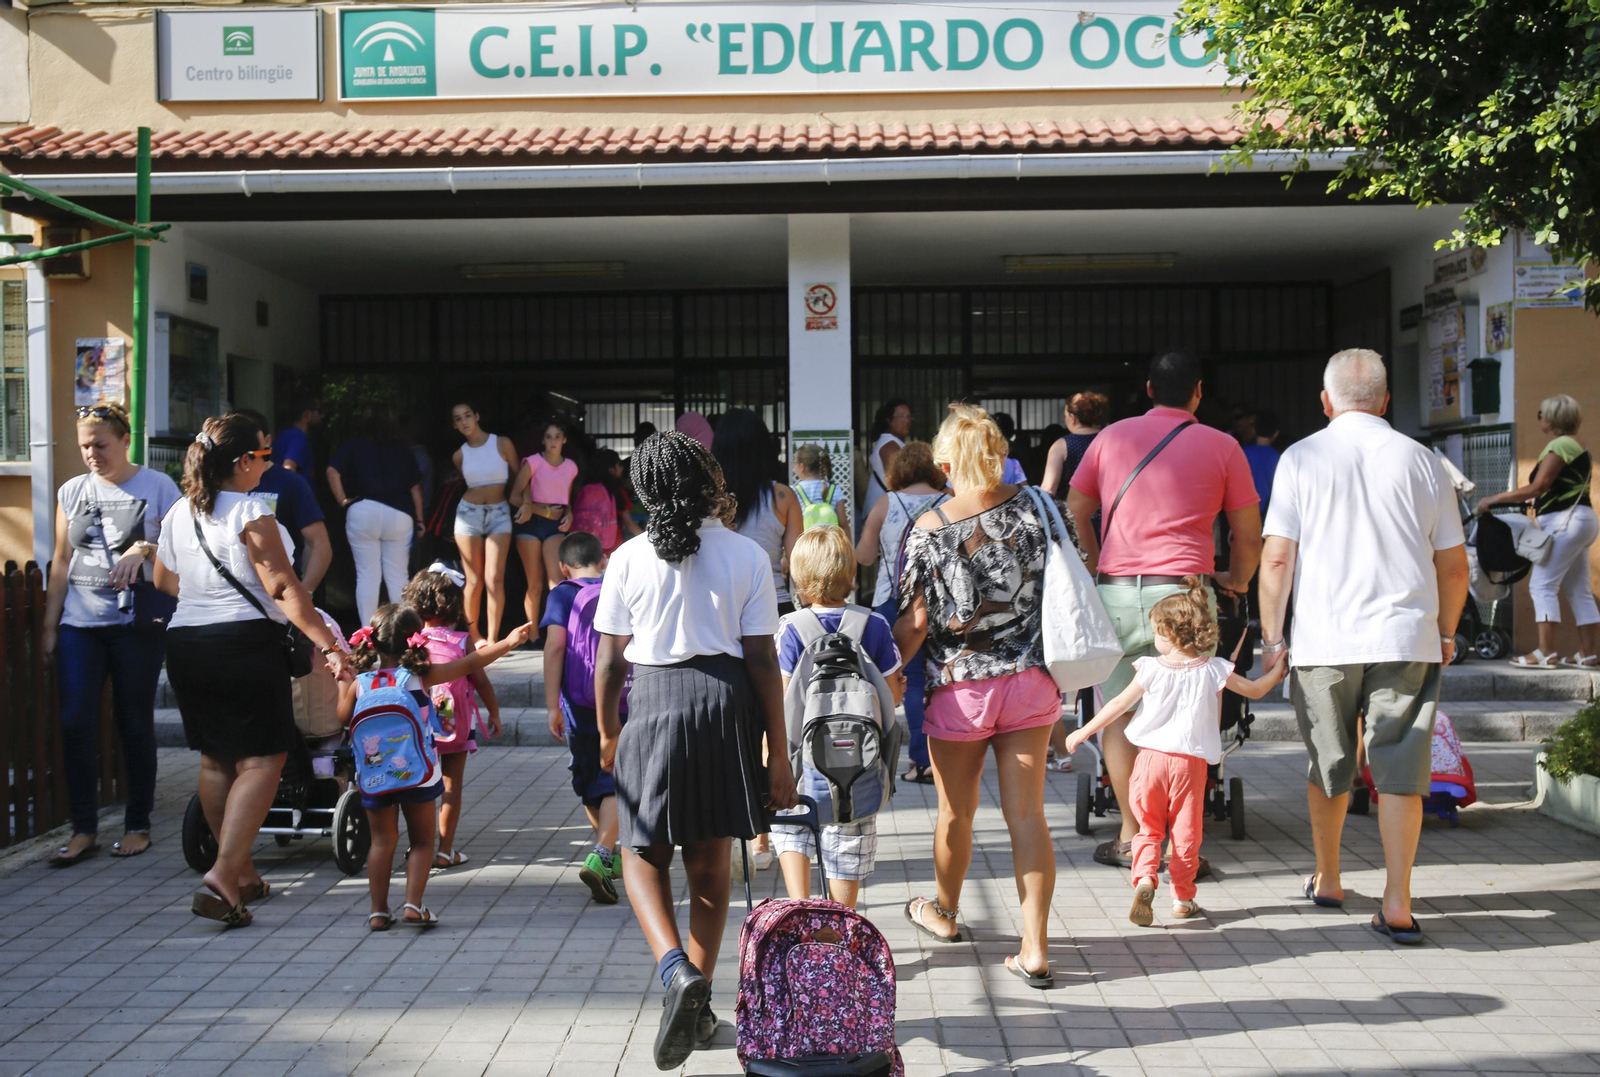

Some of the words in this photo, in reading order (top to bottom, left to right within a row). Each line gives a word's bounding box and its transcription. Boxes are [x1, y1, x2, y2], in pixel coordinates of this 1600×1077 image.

[469, 23, 662, 79] C.E.I.P.
[185, 65, 234, 81] Centro
[238, 64, 293, 84] bilingüe
[377, 66, 387, 77] DE
